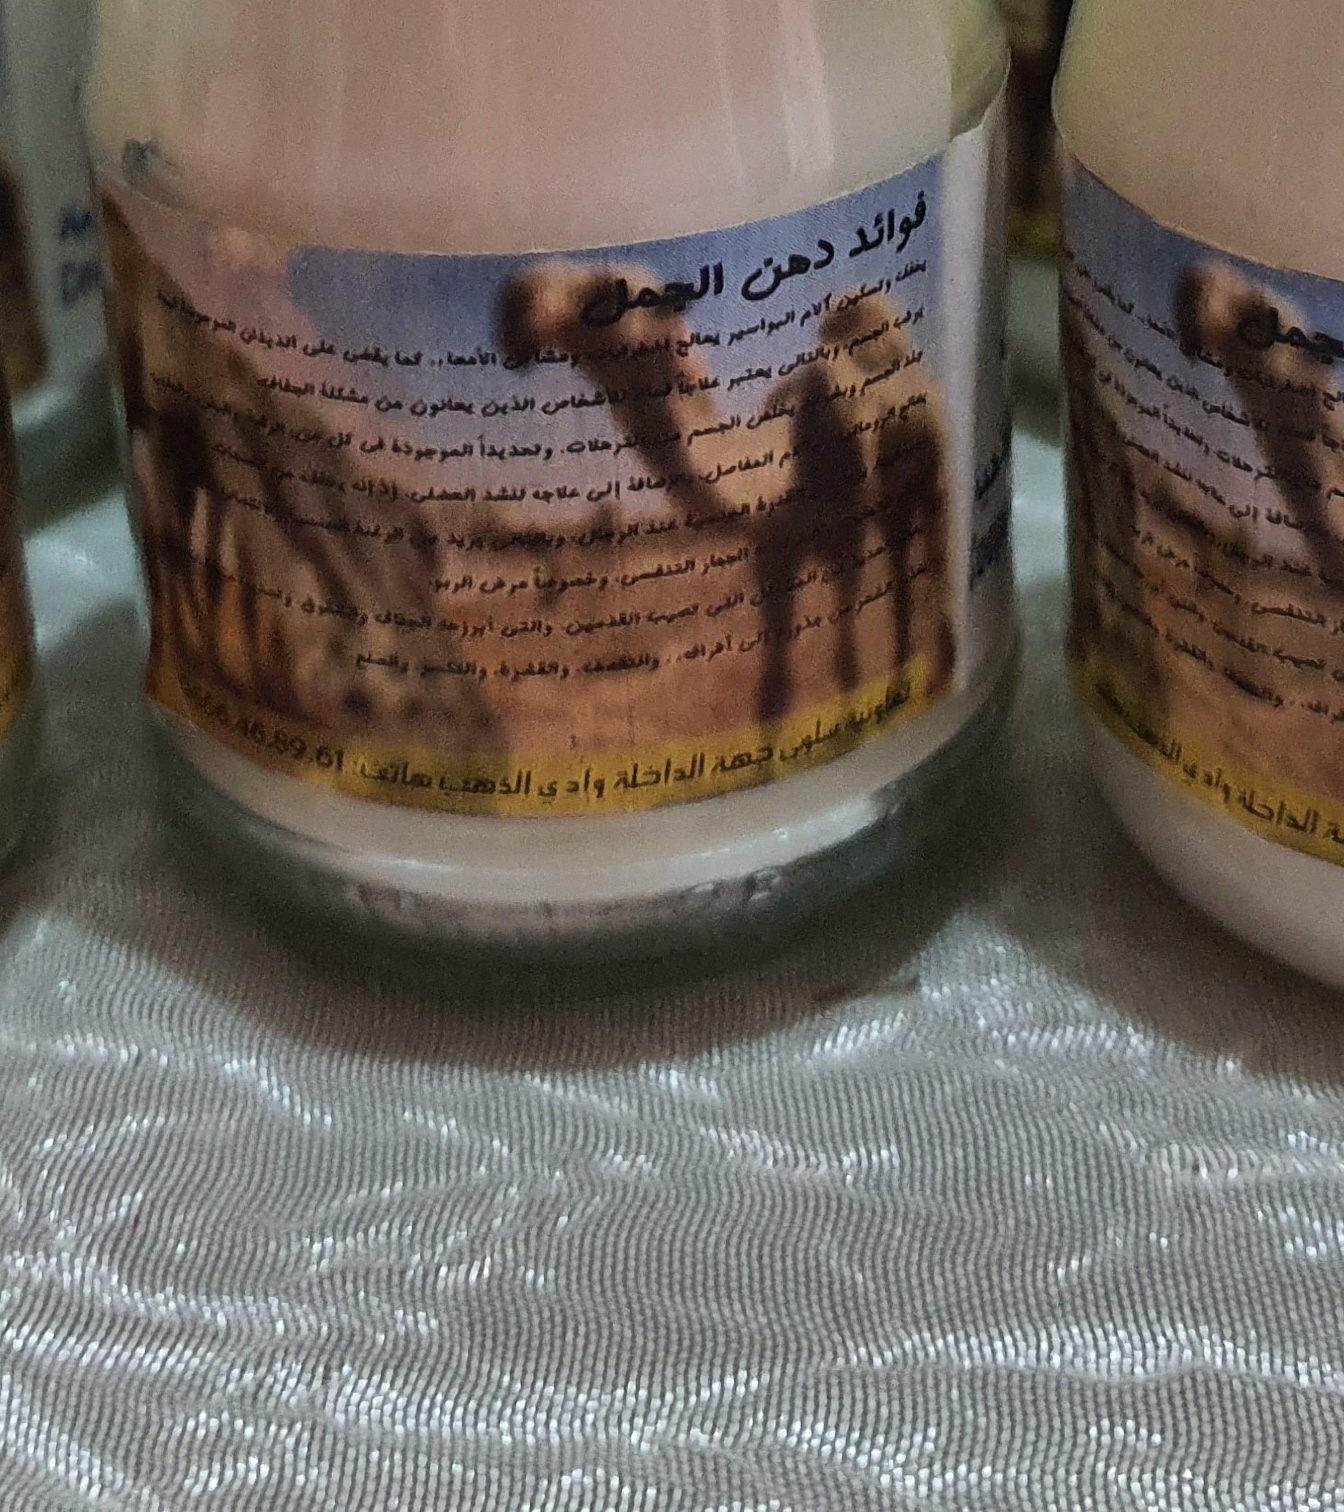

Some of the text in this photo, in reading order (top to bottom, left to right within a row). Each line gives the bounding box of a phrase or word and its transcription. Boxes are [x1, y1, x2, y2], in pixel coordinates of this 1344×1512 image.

[578, 190, 927, 328] فوائد دهن الجمل
[613, 752, 706, 791] الداخلة
